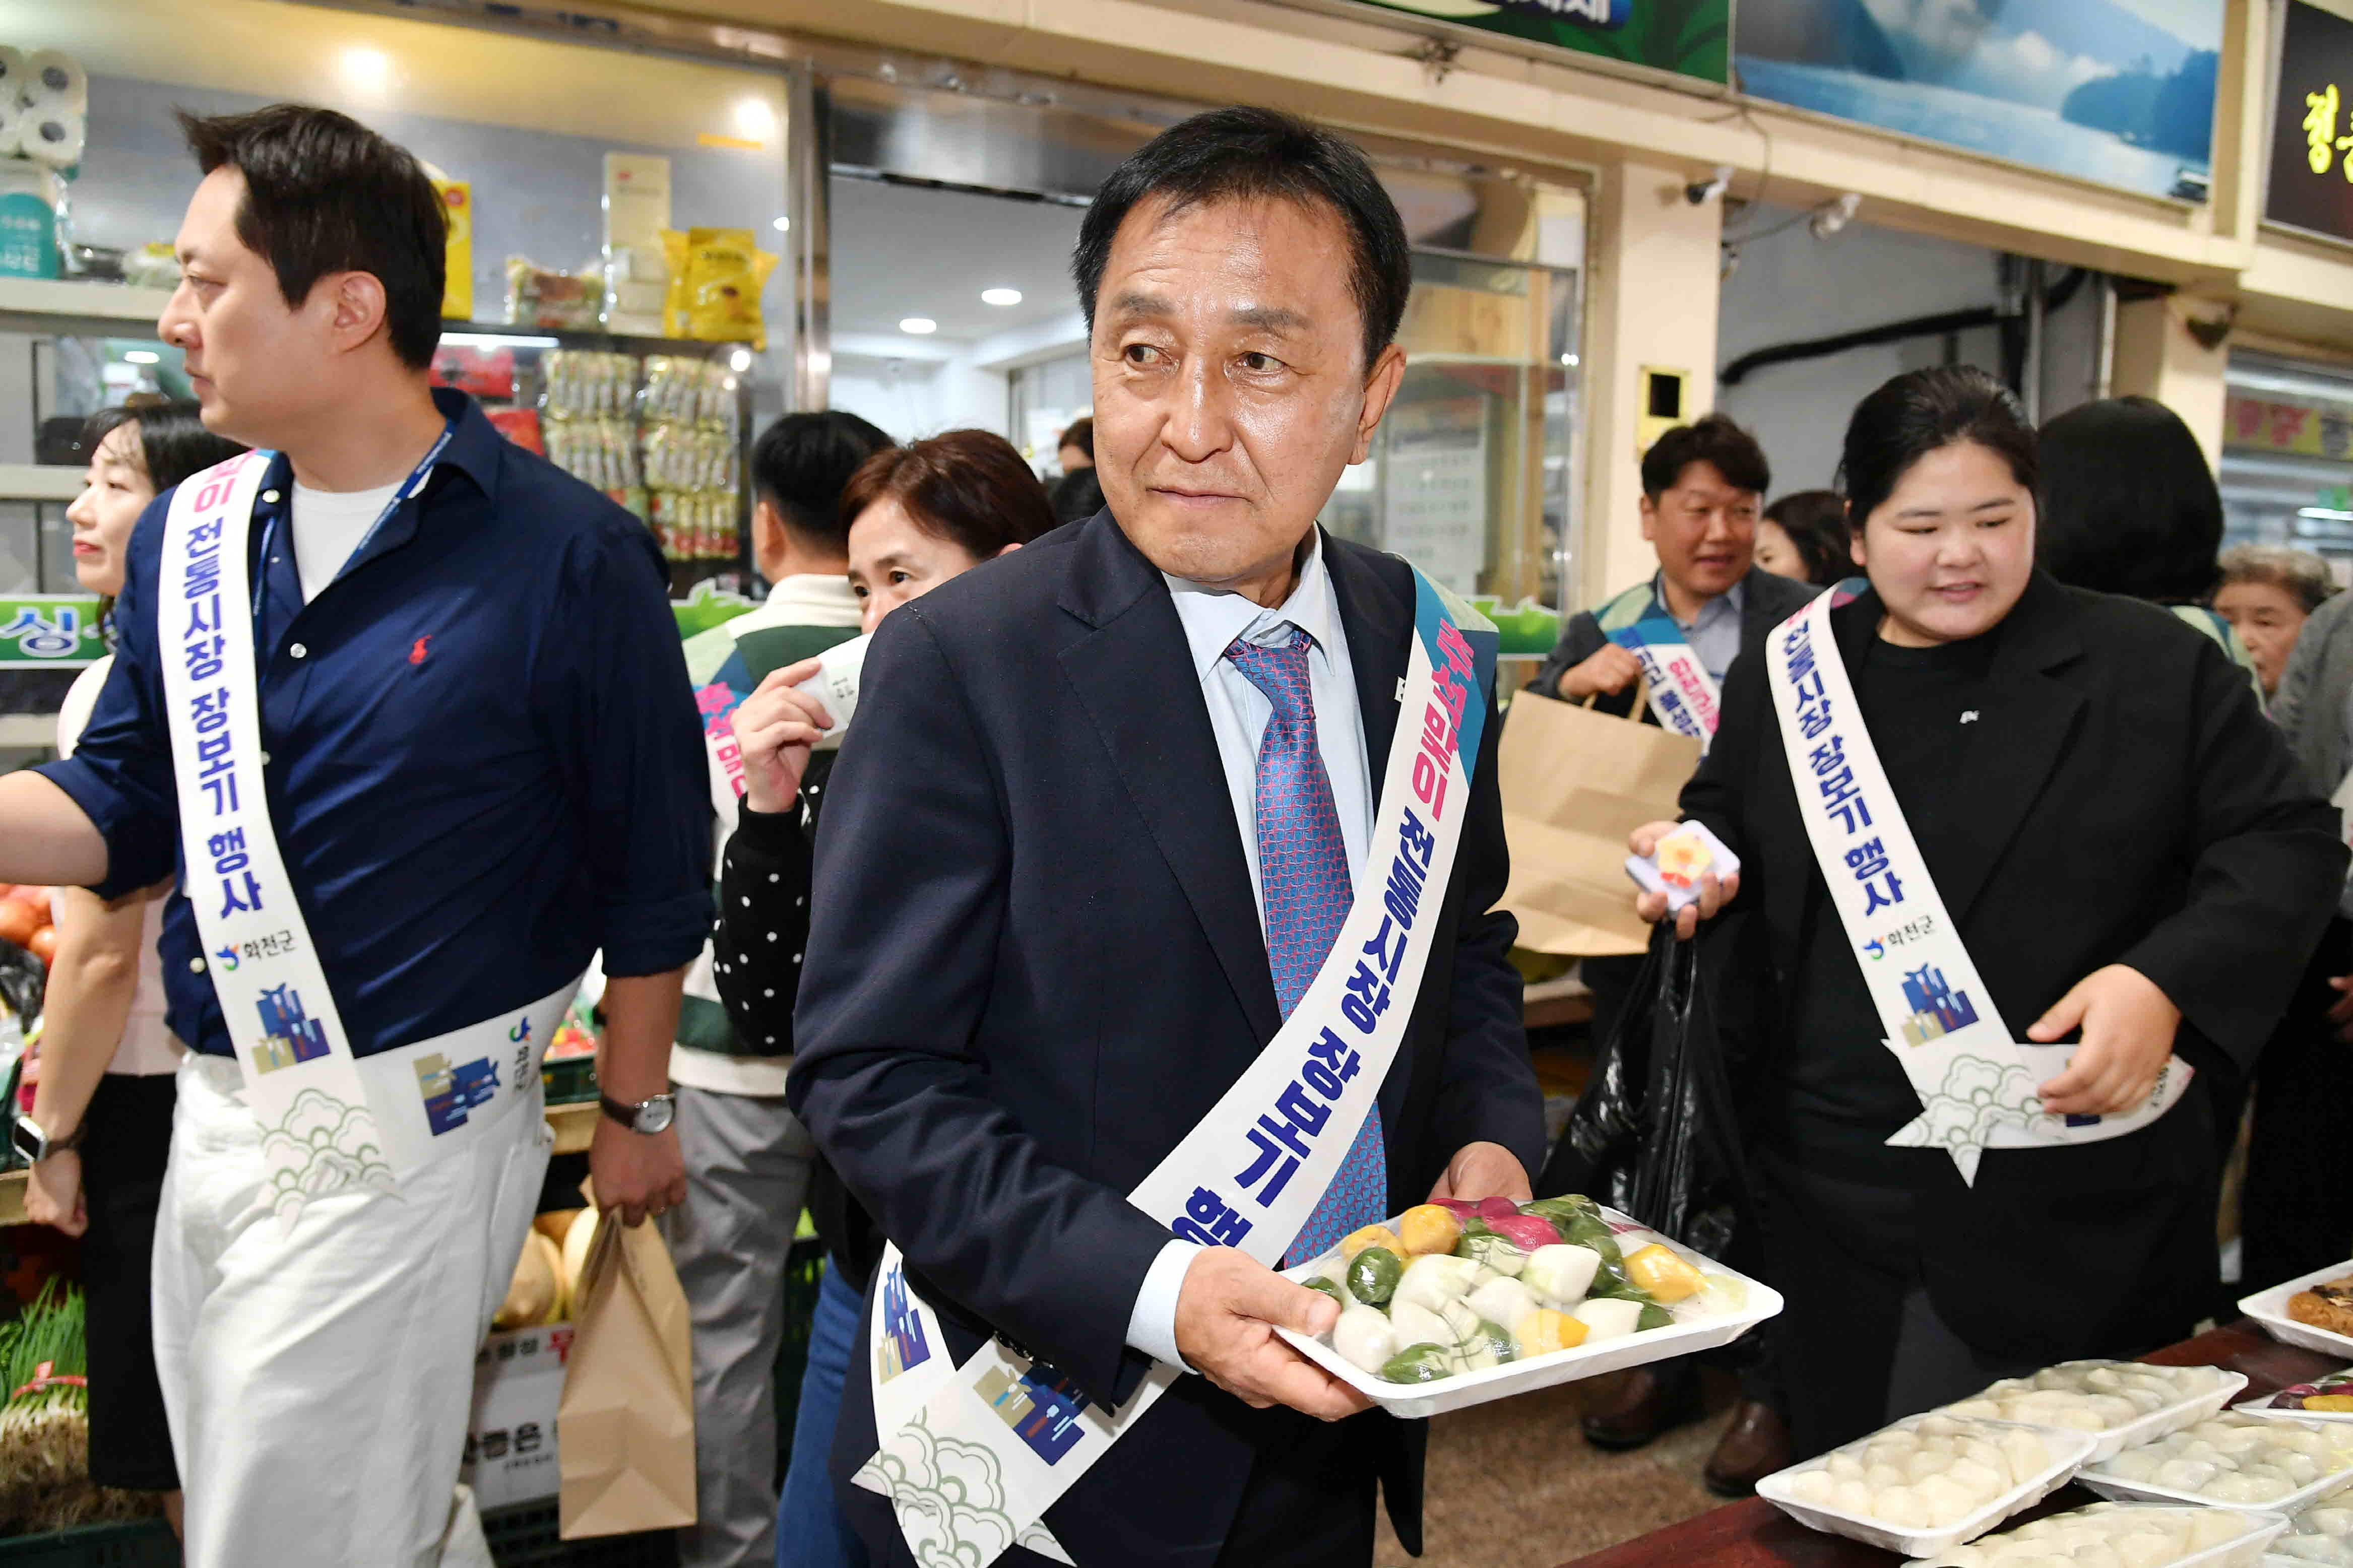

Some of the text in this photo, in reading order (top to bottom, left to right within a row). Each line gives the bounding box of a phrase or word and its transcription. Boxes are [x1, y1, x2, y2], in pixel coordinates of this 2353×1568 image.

[185, 516, 225, 681] 전통시장
[192, 687, 239, 815] 장보기
[1411, 617, 1475, 822] 추석맞이
[208, 827, 263, 919] 행사
[1809, 734, 1872, 834] 장보기
[1845, 836, 1904, 917] 행사
[244, 929, 296, 959] 화천군
[1341, 806, 1435, 1034] 전통시장
[1234, 1026, 1361, 1208] 장보기
[1172, 1185, 1253, 1248] 행
